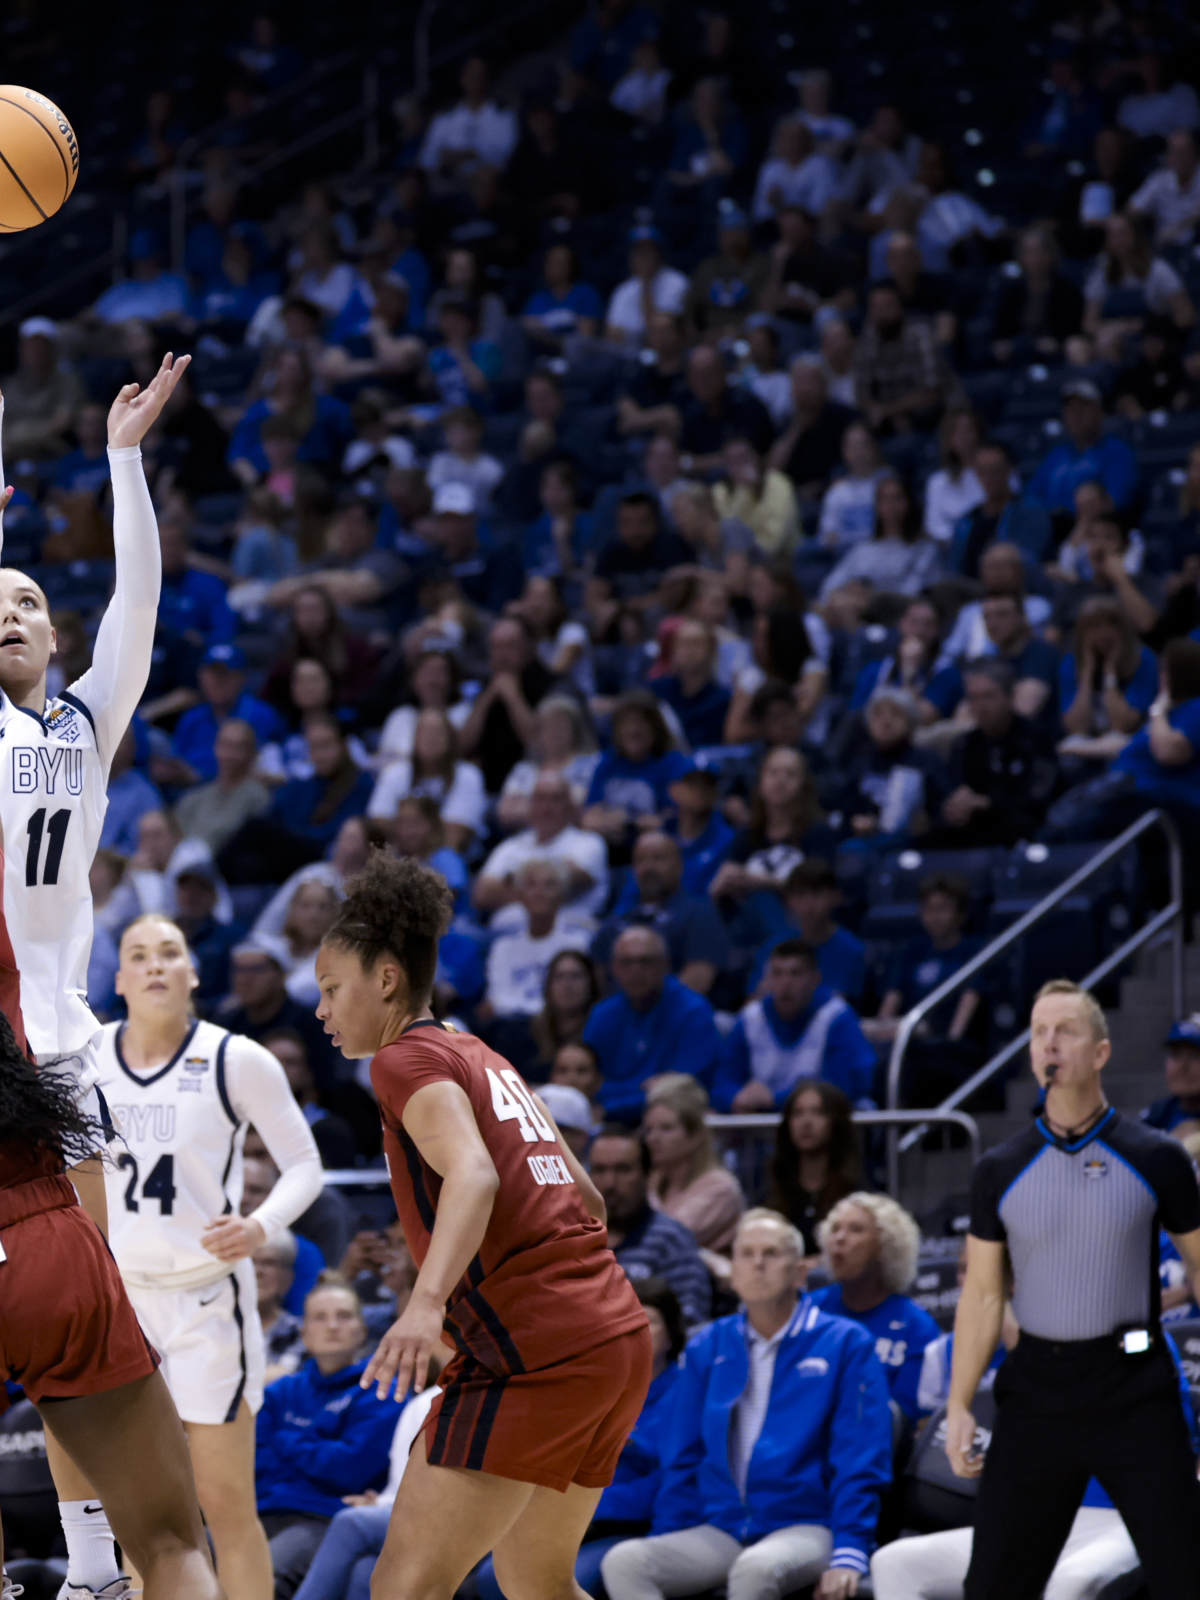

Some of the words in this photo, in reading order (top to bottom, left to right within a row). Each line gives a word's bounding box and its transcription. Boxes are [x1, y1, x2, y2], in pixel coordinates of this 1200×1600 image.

[12, 747, 83, 796] BYU
[25, 808, 72, 887] 11
[112, 1105, 176, 1143] BYU
[485, 1067, 556, 1143] 40
[118, 1153, 176, 1216] 24
